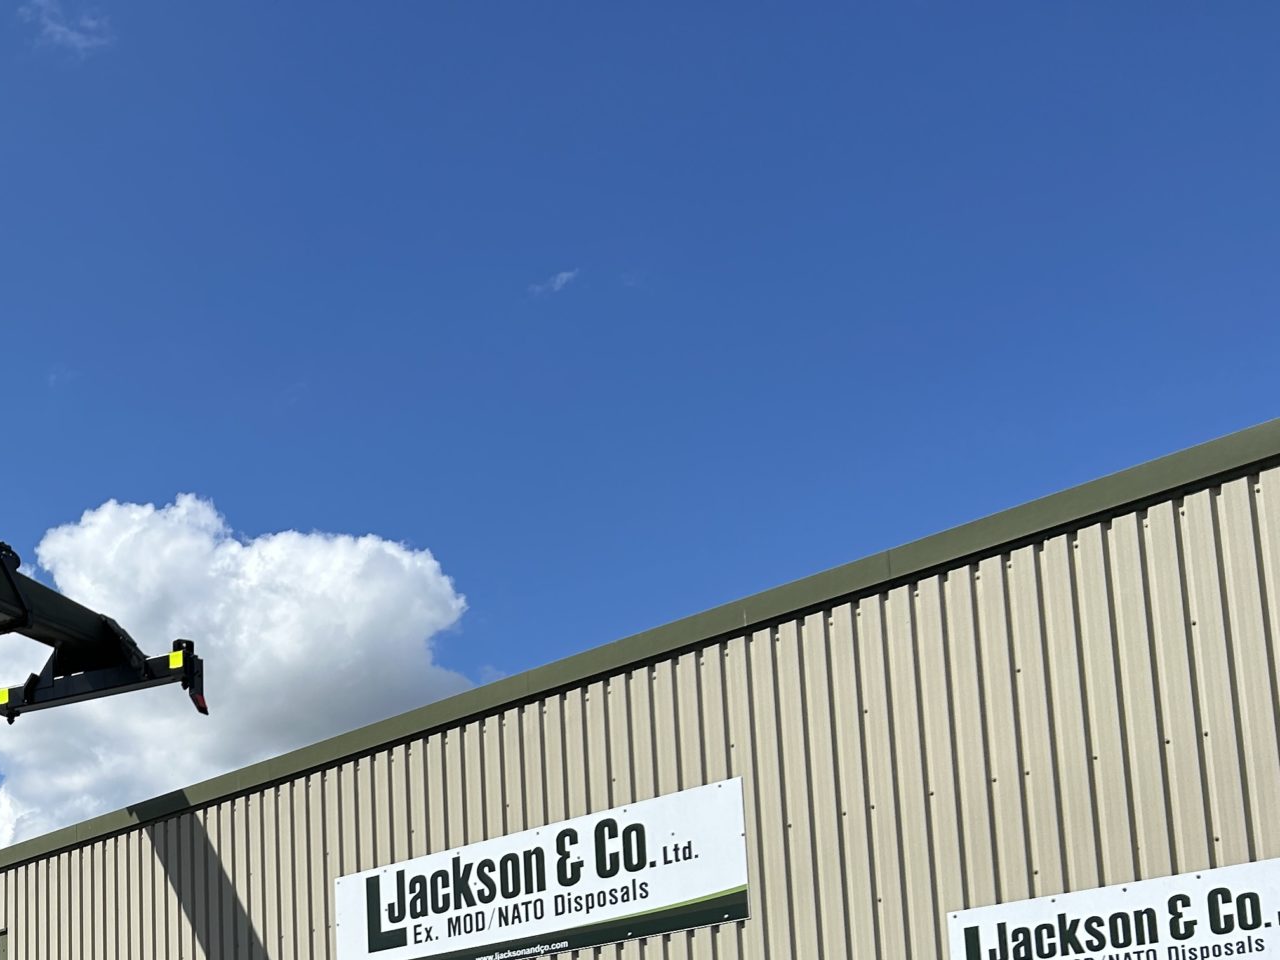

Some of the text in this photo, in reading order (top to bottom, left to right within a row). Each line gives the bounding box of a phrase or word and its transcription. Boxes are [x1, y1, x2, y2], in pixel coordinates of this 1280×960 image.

[556, 828, 584, 887] &
[594, 818, 657, 879] Co.
[662, 840, 699, 866] Ltd.
[413, 878, 650, 945] Ex. MOD/NATO Disposals
[1168, 893, 1197, 941] &
[1207, 887, 1272, 935] Co.
